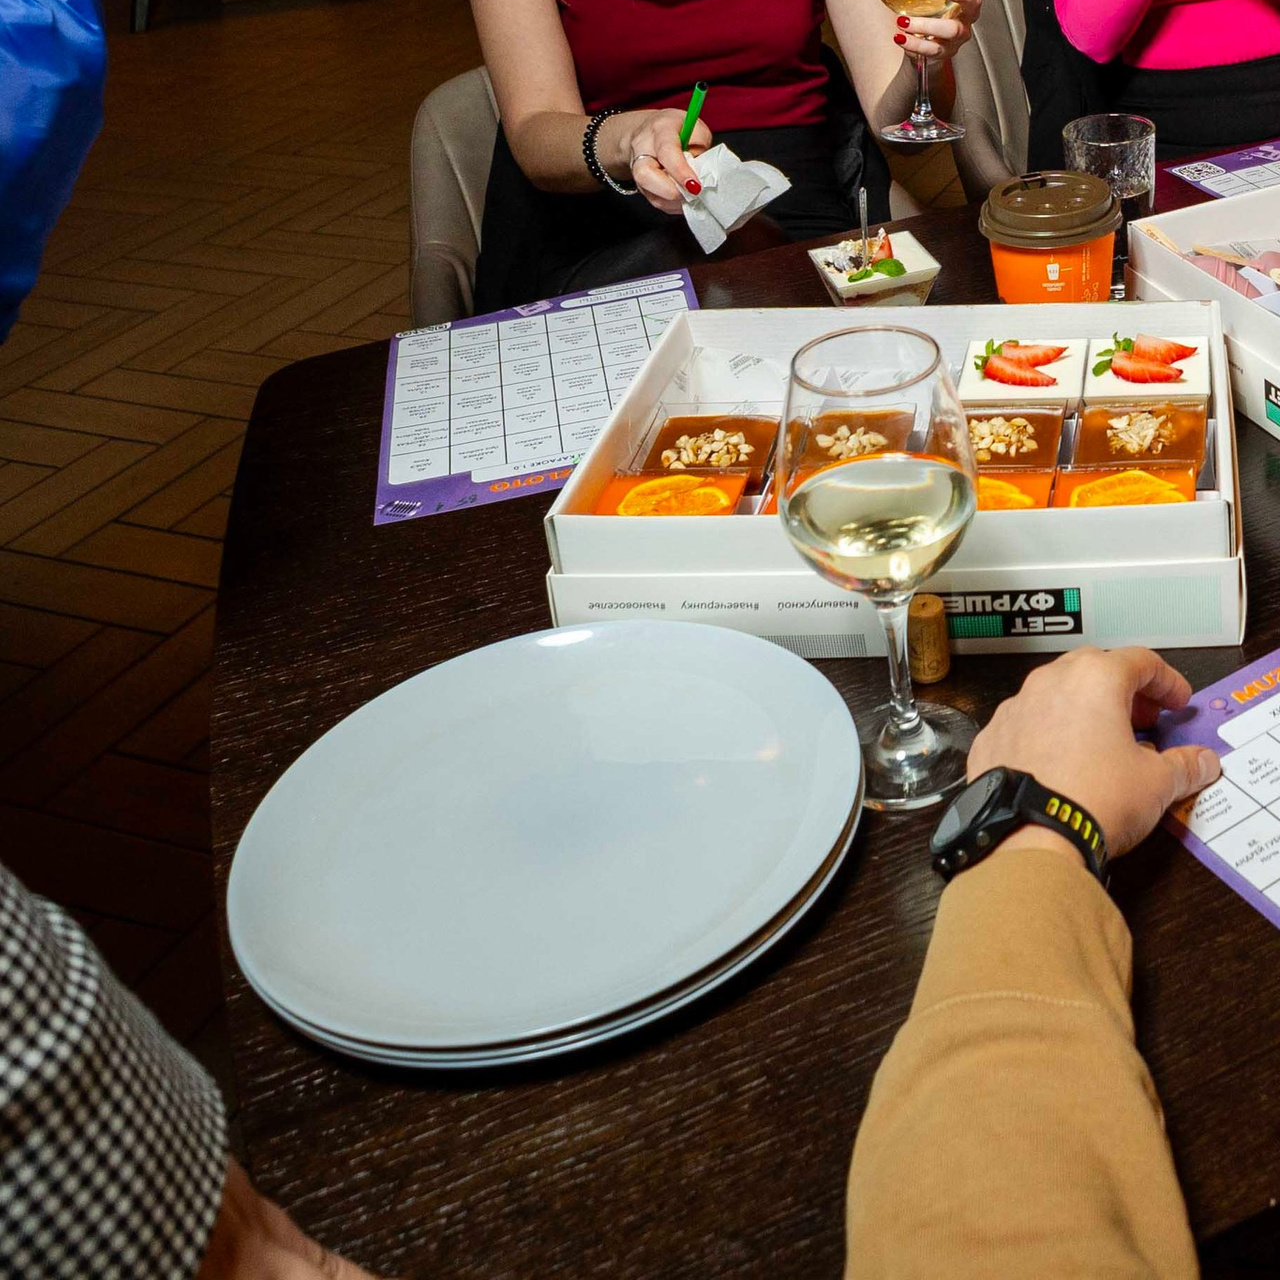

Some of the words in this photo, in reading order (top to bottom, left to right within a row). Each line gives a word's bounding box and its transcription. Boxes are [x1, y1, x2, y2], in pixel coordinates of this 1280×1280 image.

[617, 285, 654, 296] ПИТЕРЕ
[527, 455, 574, 467] КАРАОКЕ
[588, 601, 666, 612] #нановоселье
[680, 598, 760, 612] #навечеринку
[777, 599, 859, 612] #навыпускной
[942, 591, 1055, 612] ФУРШЕ
[1010, 615, 1075, 633] СЕТ
